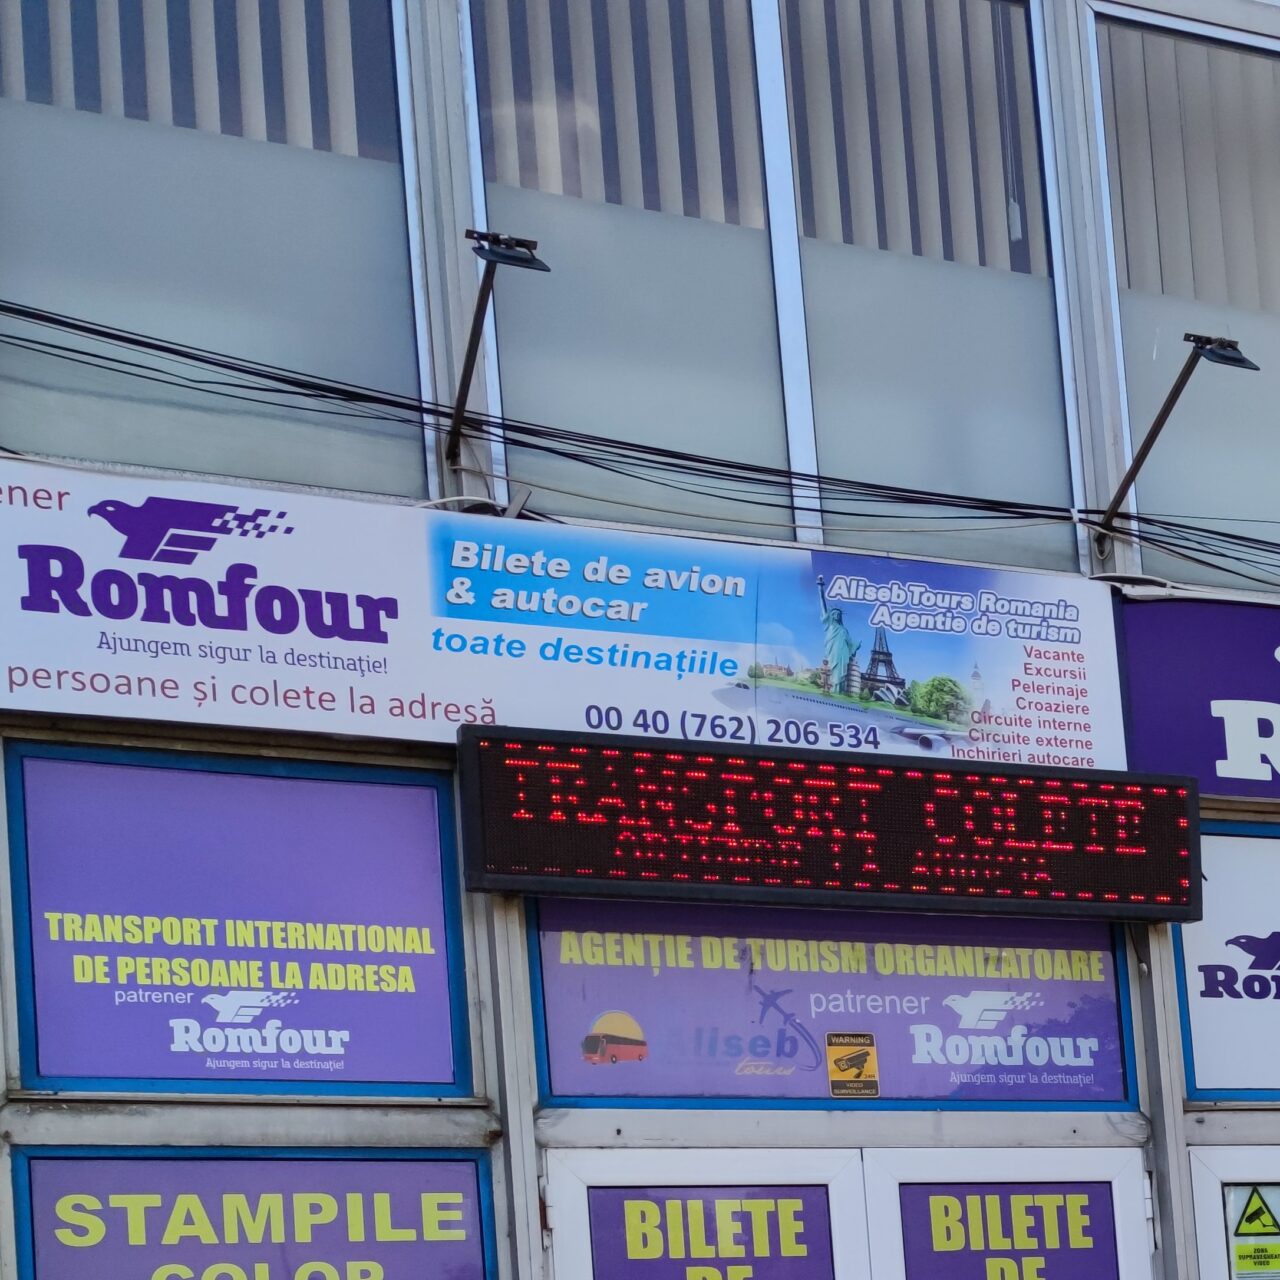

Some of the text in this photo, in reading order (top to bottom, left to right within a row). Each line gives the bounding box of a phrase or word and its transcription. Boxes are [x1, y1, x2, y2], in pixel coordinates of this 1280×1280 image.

[0, 485, 71, 511] ner
[451, 541, 746, 597] Bilete de avion
[18, 544, 398, 644] Romfour
[446, 577, 648, 621] & autocar
[978, 591, 1080, 622] Romania
[869, 603, 1081, 644] Agentie de turism
[97, 631, 192, 660] Ajungem
[198, 642, 252, 667] sigur
[260, 645, 278, 664] la
[432, 628, 738, 680] toate destinațiile
[1023, 645, 1085, 663] Vacante
[1011, 679, 1089, 700] Pelerinaje
[1023, 662, 1087, 681] Excursii
[8, 664, 496, 725] persoane și colete la adresă
[1015, 697, 1090, 716] Croaziere
[585, 705, 880, 750] 00 40 (762) 206 534
[968, 728, 1093, 750] Circuite externe
[970, 711, 1092, 733] Circuite interne
[951, 745, 1095, 768] Inchirieri autocare
[44, 912, 435, 955] TRANSPORT INTERNATIONAL
[72, 955, 416, 993] DE PERSOANE LA ADRESA
[701, 936, 741, 970] DE
[748, 939, 867, 973] TURISM
[874, 942, 1105, 982] ORGANIZATOARE
[115, 989, 194, 1006] patrener
[810, 989, 931, 1018] patrener
[169, 1019, 350, 1055] Romfour
[909, 1024, 1099, 1067] Romfour
[54, 1192, 466, 1247] STAMPILE
[624, 1199, 807, 1259] BILETE
[929, 1194, 1093, 1251] BILETE
